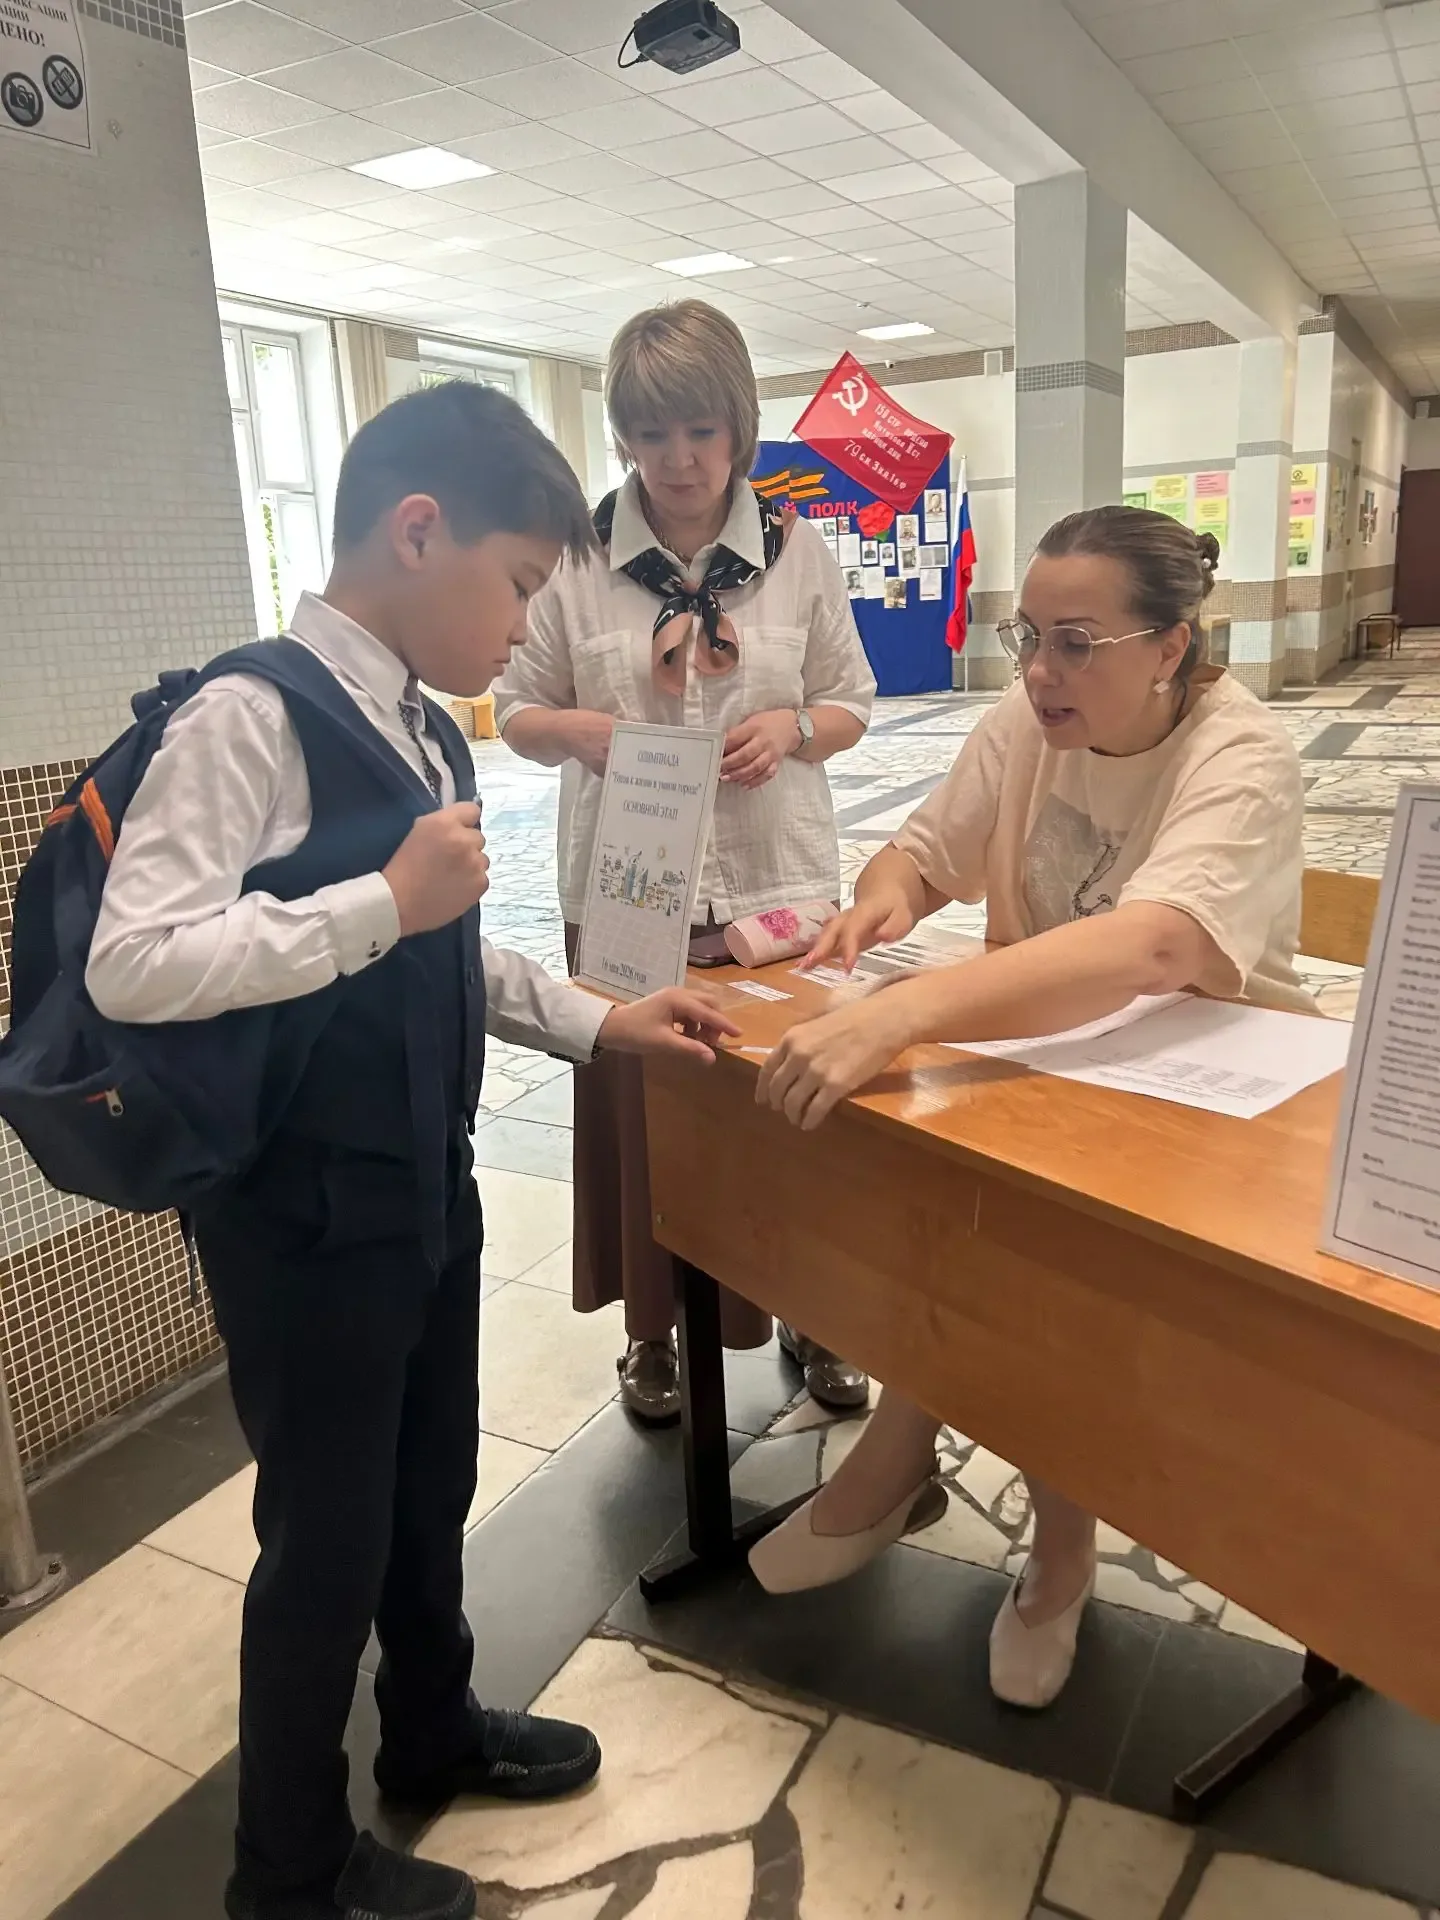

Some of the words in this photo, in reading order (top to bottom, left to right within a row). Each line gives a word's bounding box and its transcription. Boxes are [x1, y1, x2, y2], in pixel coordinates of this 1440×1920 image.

[844, 439, 862, 457] 79
[809, 500, 859, 518] ПОЛК
[637, 749, 680, 768] ОЛИМПИАДА
[623, 799, 660, 818] ОСНОВНОЙ
[660, 805, 679, 820] ЭТАП
